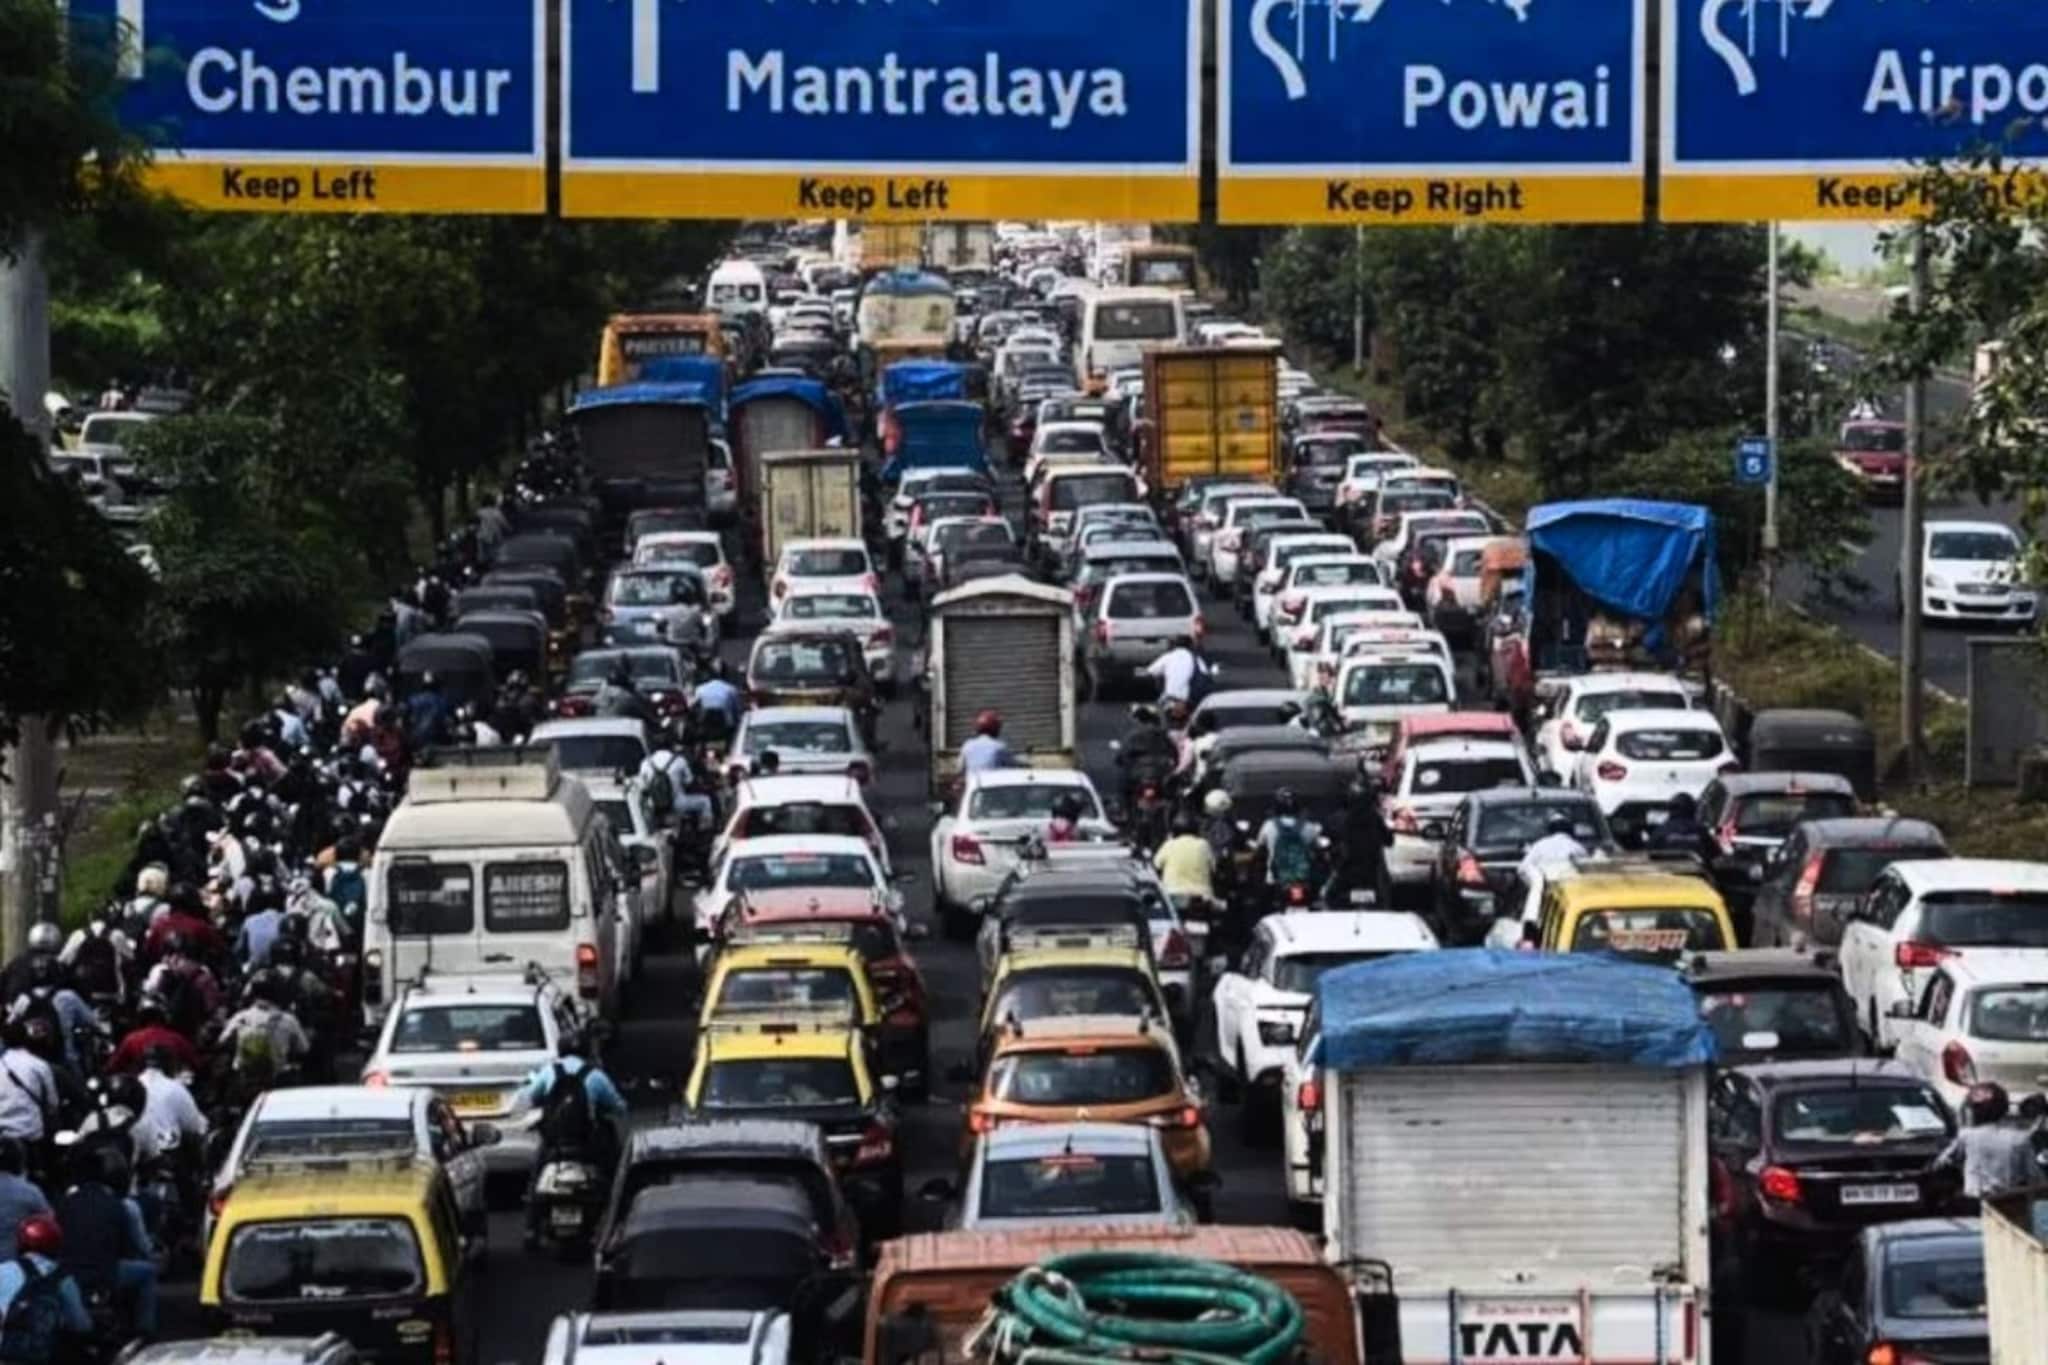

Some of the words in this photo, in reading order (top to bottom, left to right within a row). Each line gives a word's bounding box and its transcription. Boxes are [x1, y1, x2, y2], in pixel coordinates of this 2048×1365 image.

[187, 48, 510, 115] Chembur
[727, 49, 1127, 128] Mantralaya
[1404, 65, 1610, 129] Powai
[222, 167, 302, 204] Keep
[312, 167, 377, 199] Left
[798, 178, 876, 215] Keep
[886, 178, 948, 210] Left
[1326, 180, 1414, 216] Keep
[1427, 180, 1523, 216] Right
[1816, 177, 1906, 212] Keep
[1459, 1322, 1584, 1357] TATA
